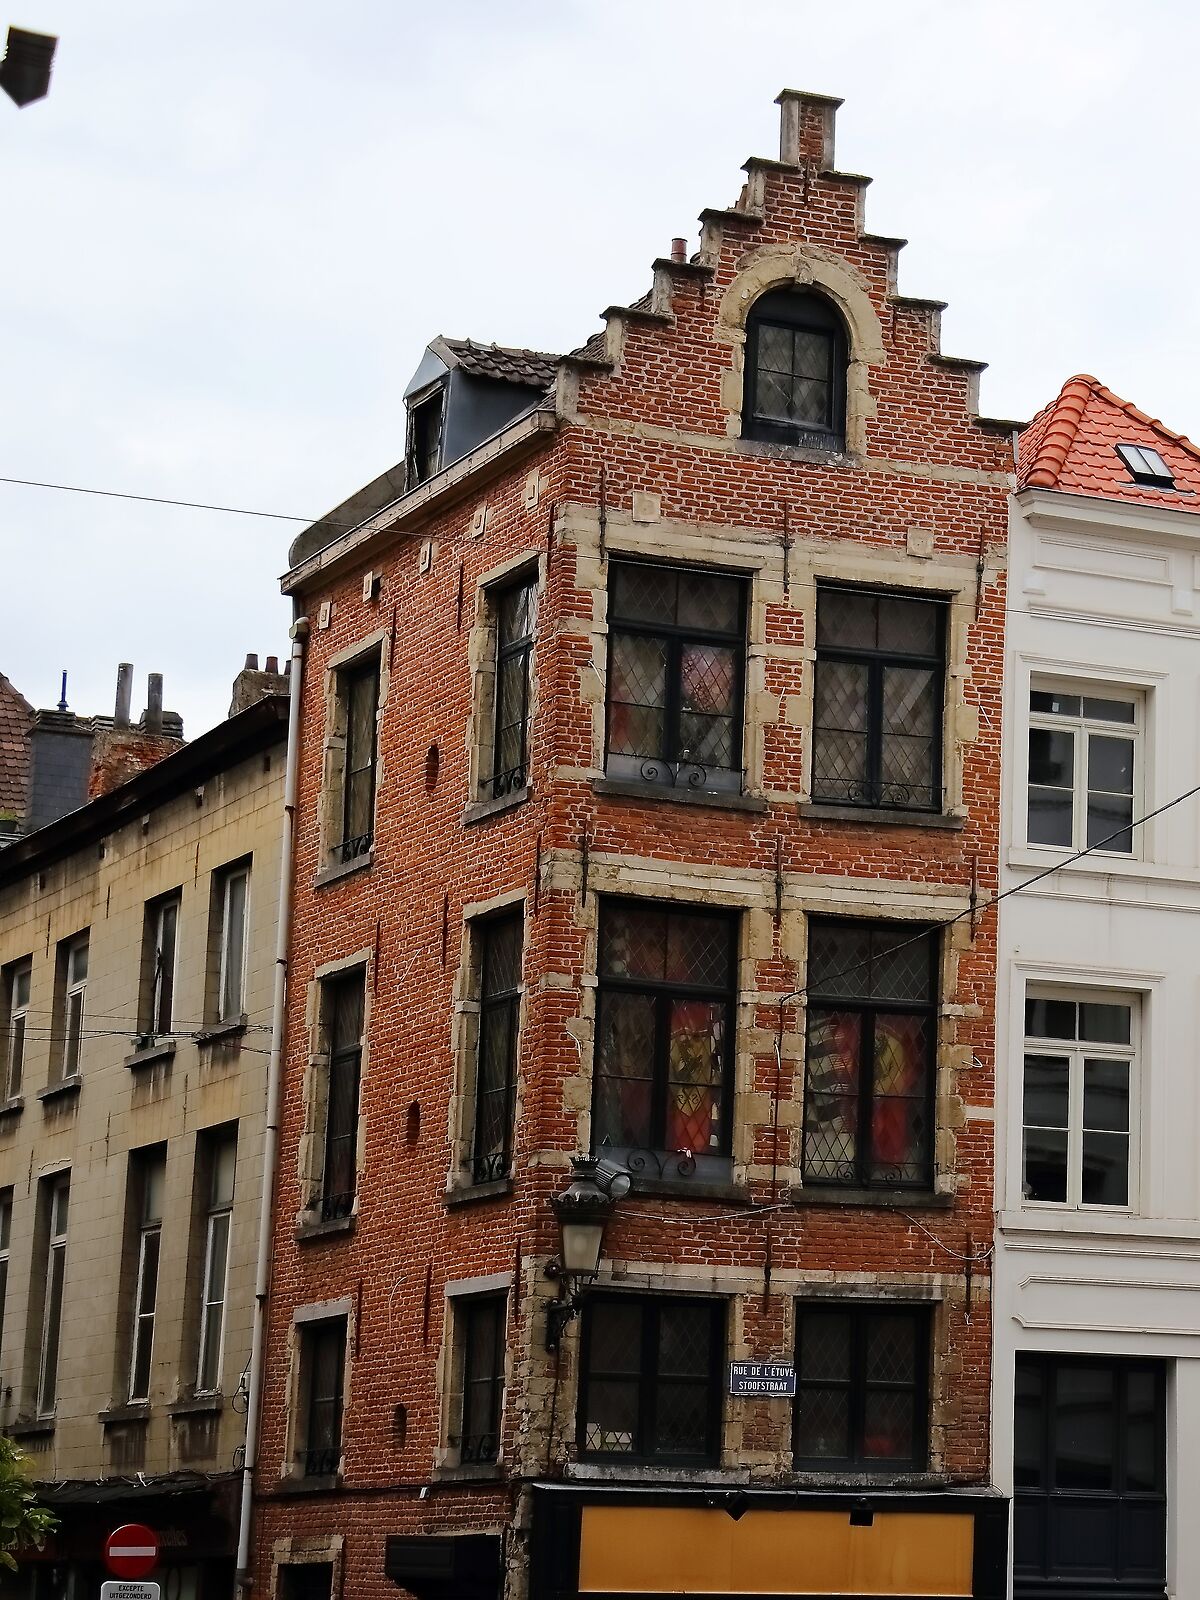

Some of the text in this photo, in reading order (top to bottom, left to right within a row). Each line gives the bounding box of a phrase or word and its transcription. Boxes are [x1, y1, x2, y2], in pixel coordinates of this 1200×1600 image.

[733, 1366, 748, 1375] RUE
[751, 1366, 761, 1376] DE
[738, 1381, 788, 1391] STOOFSTRAAT
